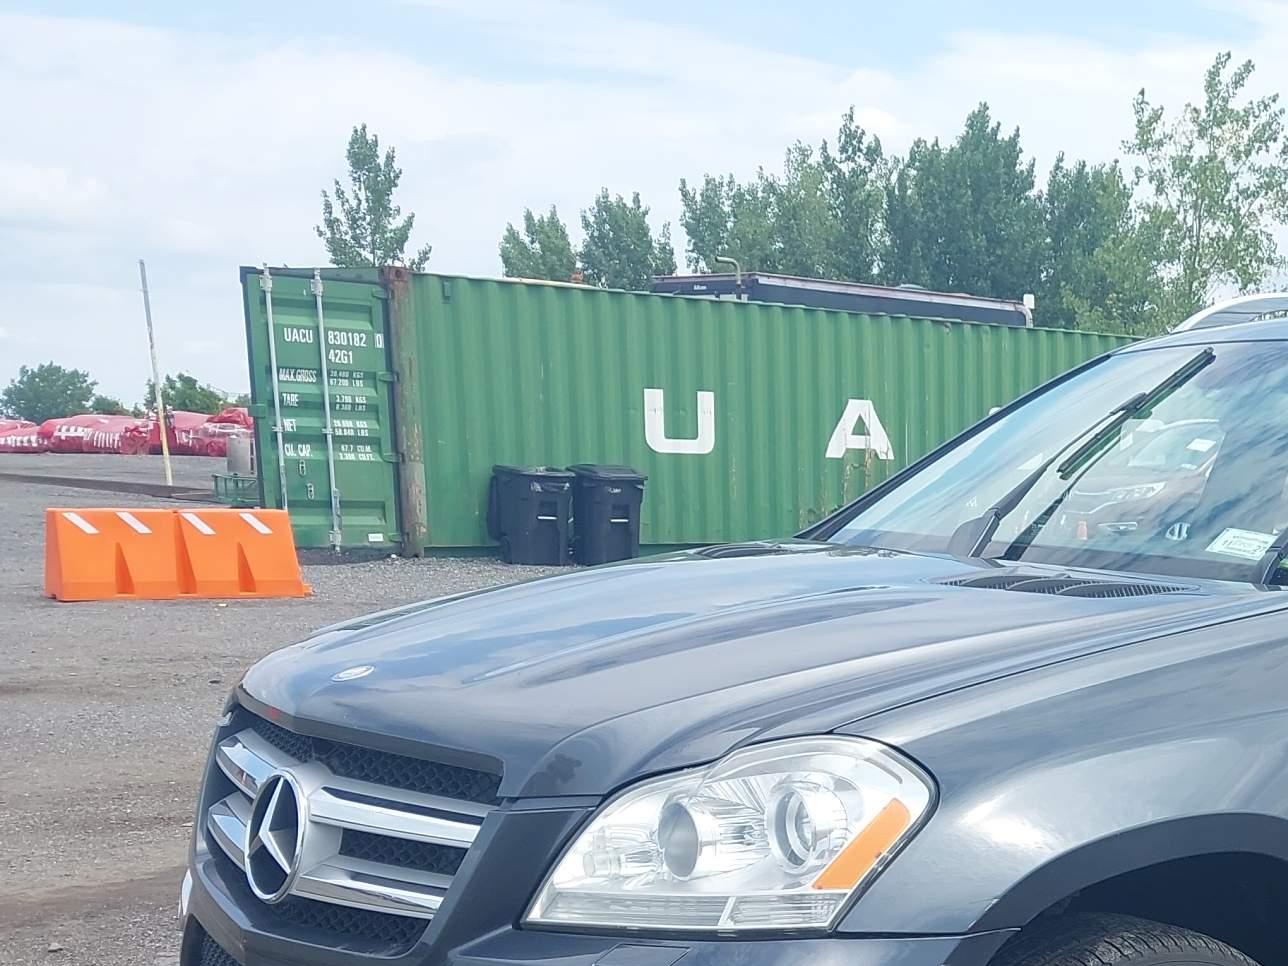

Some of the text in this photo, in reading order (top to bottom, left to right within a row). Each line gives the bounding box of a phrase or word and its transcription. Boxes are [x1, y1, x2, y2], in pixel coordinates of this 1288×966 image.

[283, 328, 313, 343] UACU
[327, 331, 367, 347] 830182
[328, 349, 353, 364] 42G1
[282, 393, 299, 407] TARE
